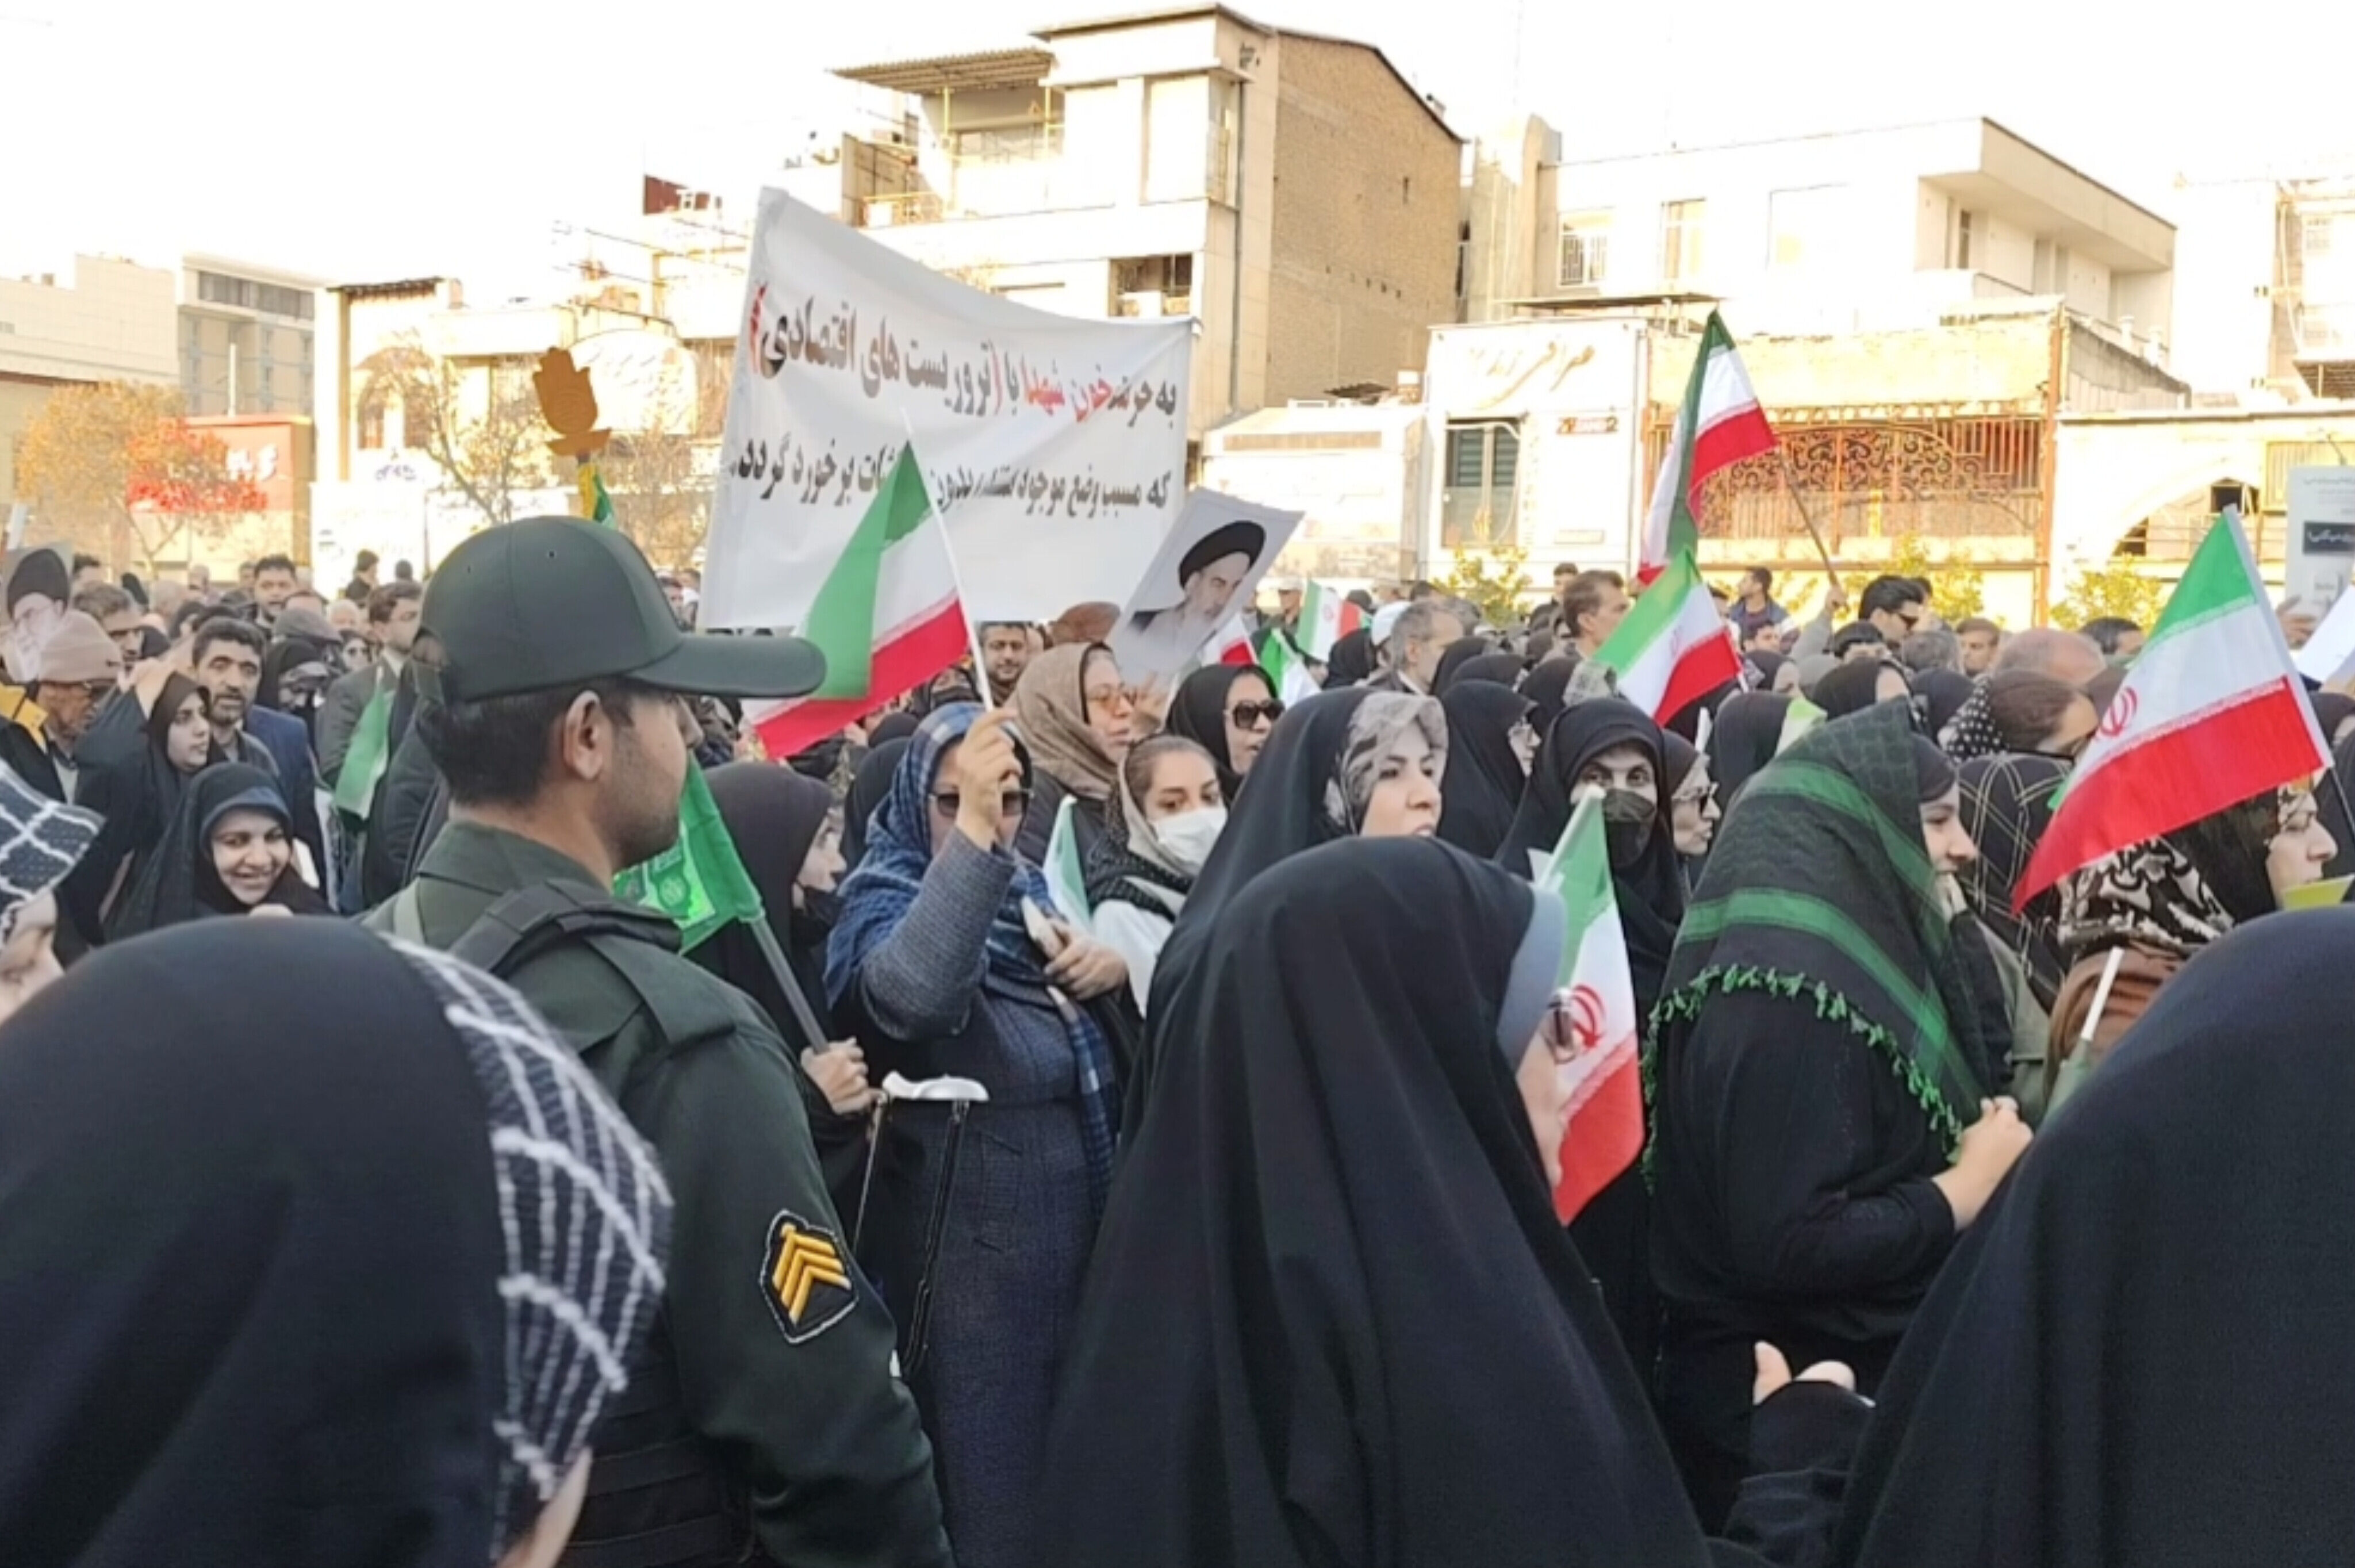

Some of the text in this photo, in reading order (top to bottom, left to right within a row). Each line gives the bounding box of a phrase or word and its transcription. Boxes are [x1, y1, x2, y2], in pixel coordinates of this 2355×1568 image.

[1004, 350, 1020, 415] با
[1020, 352, 1065, 416] شهدا
[1071, 361, 1114, 423] خون
[1155, 379, 1176, 430] به
[1148, 469, 1172, 509] که
